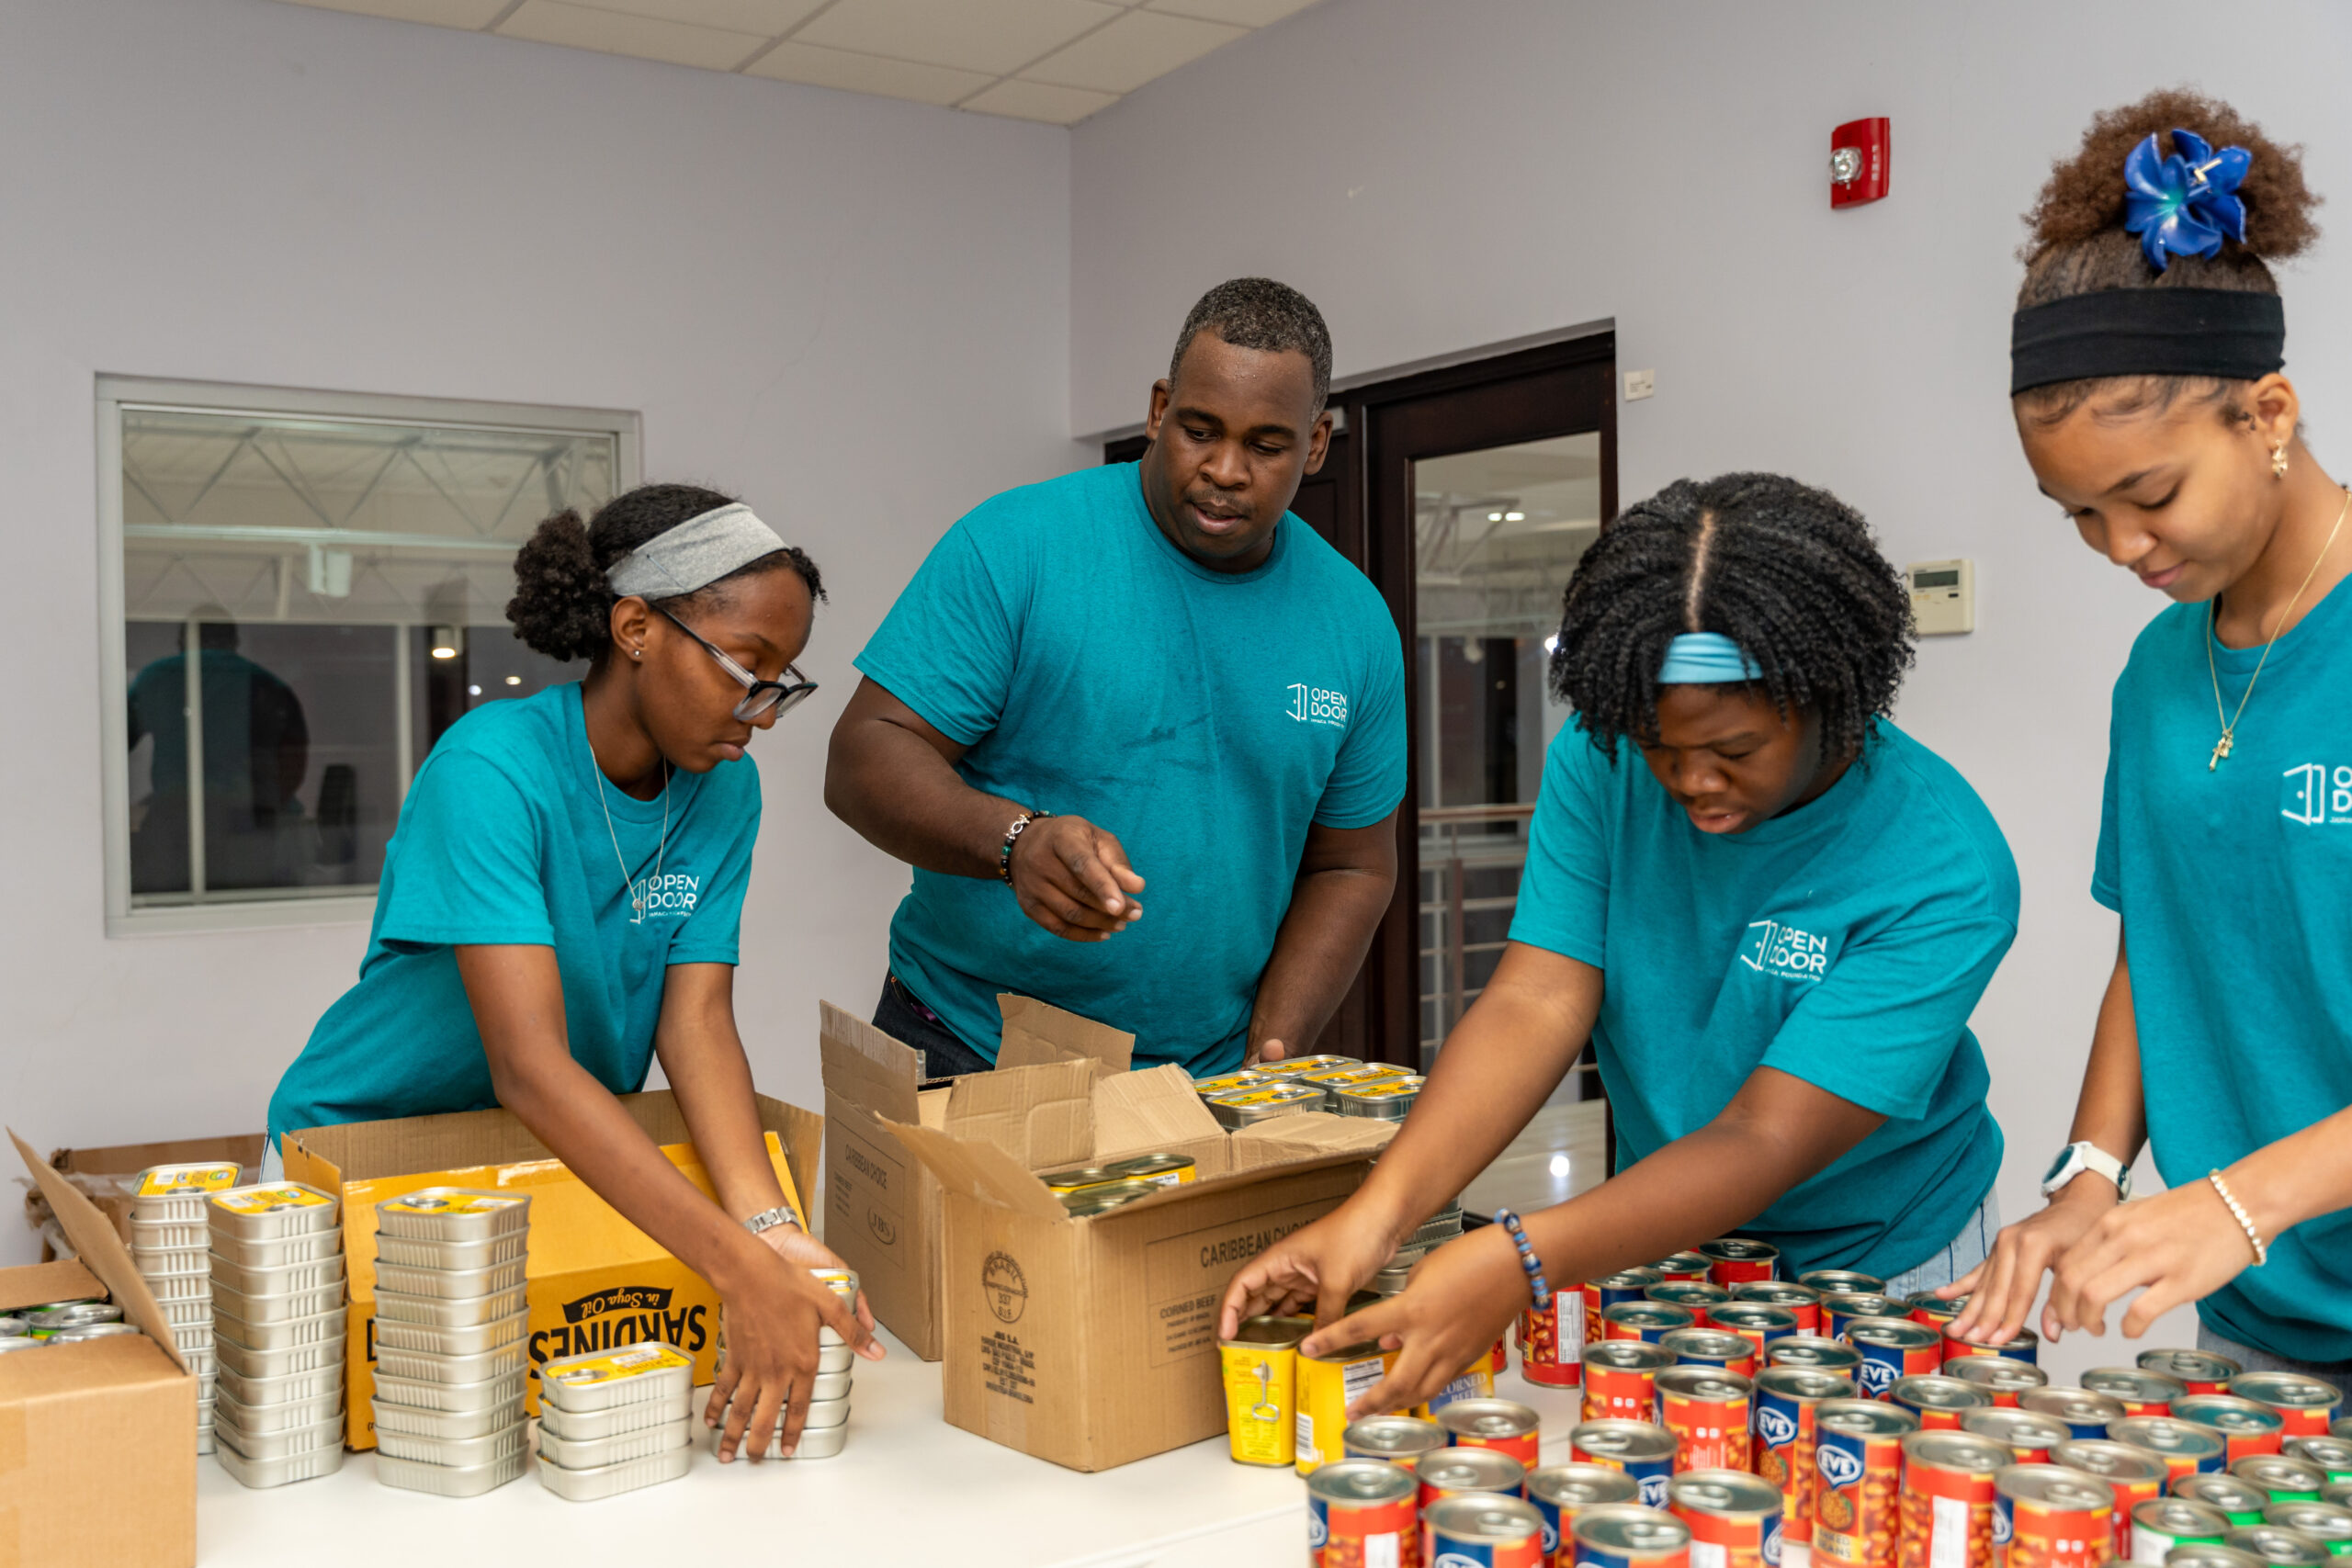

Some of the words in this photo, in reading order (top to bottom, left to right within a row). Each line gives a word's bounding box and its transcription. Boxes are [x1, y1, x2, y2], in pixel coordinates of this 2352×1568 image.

[1871, 144, 1880, 181] FIRE
[1311, 687, 1347, 706] OPEN
[1311, 702, 1347, 722] DOOR
[649, 874, 699, 891] OPEN
[649, 892, 696, 910] DOOR
[1778, 927, 1826, 953] OPEN
[1770, 945, 1826, 974] DOOR
[869, 1161, 888, 1190] CHOICE
[872, 1212, 890, 1236] JBS
[1200, 1230, 1271, 1268] CARIBBEAN
[582, 1298, 605, 1319] Oil
[607, 1288, 643, 1308] Soya
[646, 1293, 661, 1306] in
[529, 1304, 707, 1380] SARDINES
[1861, 1364, 1891, 1384] EVE
[1759, 1413, 1788, 1437] EVE
[1820, 1450, 1851, 1475] EVE
